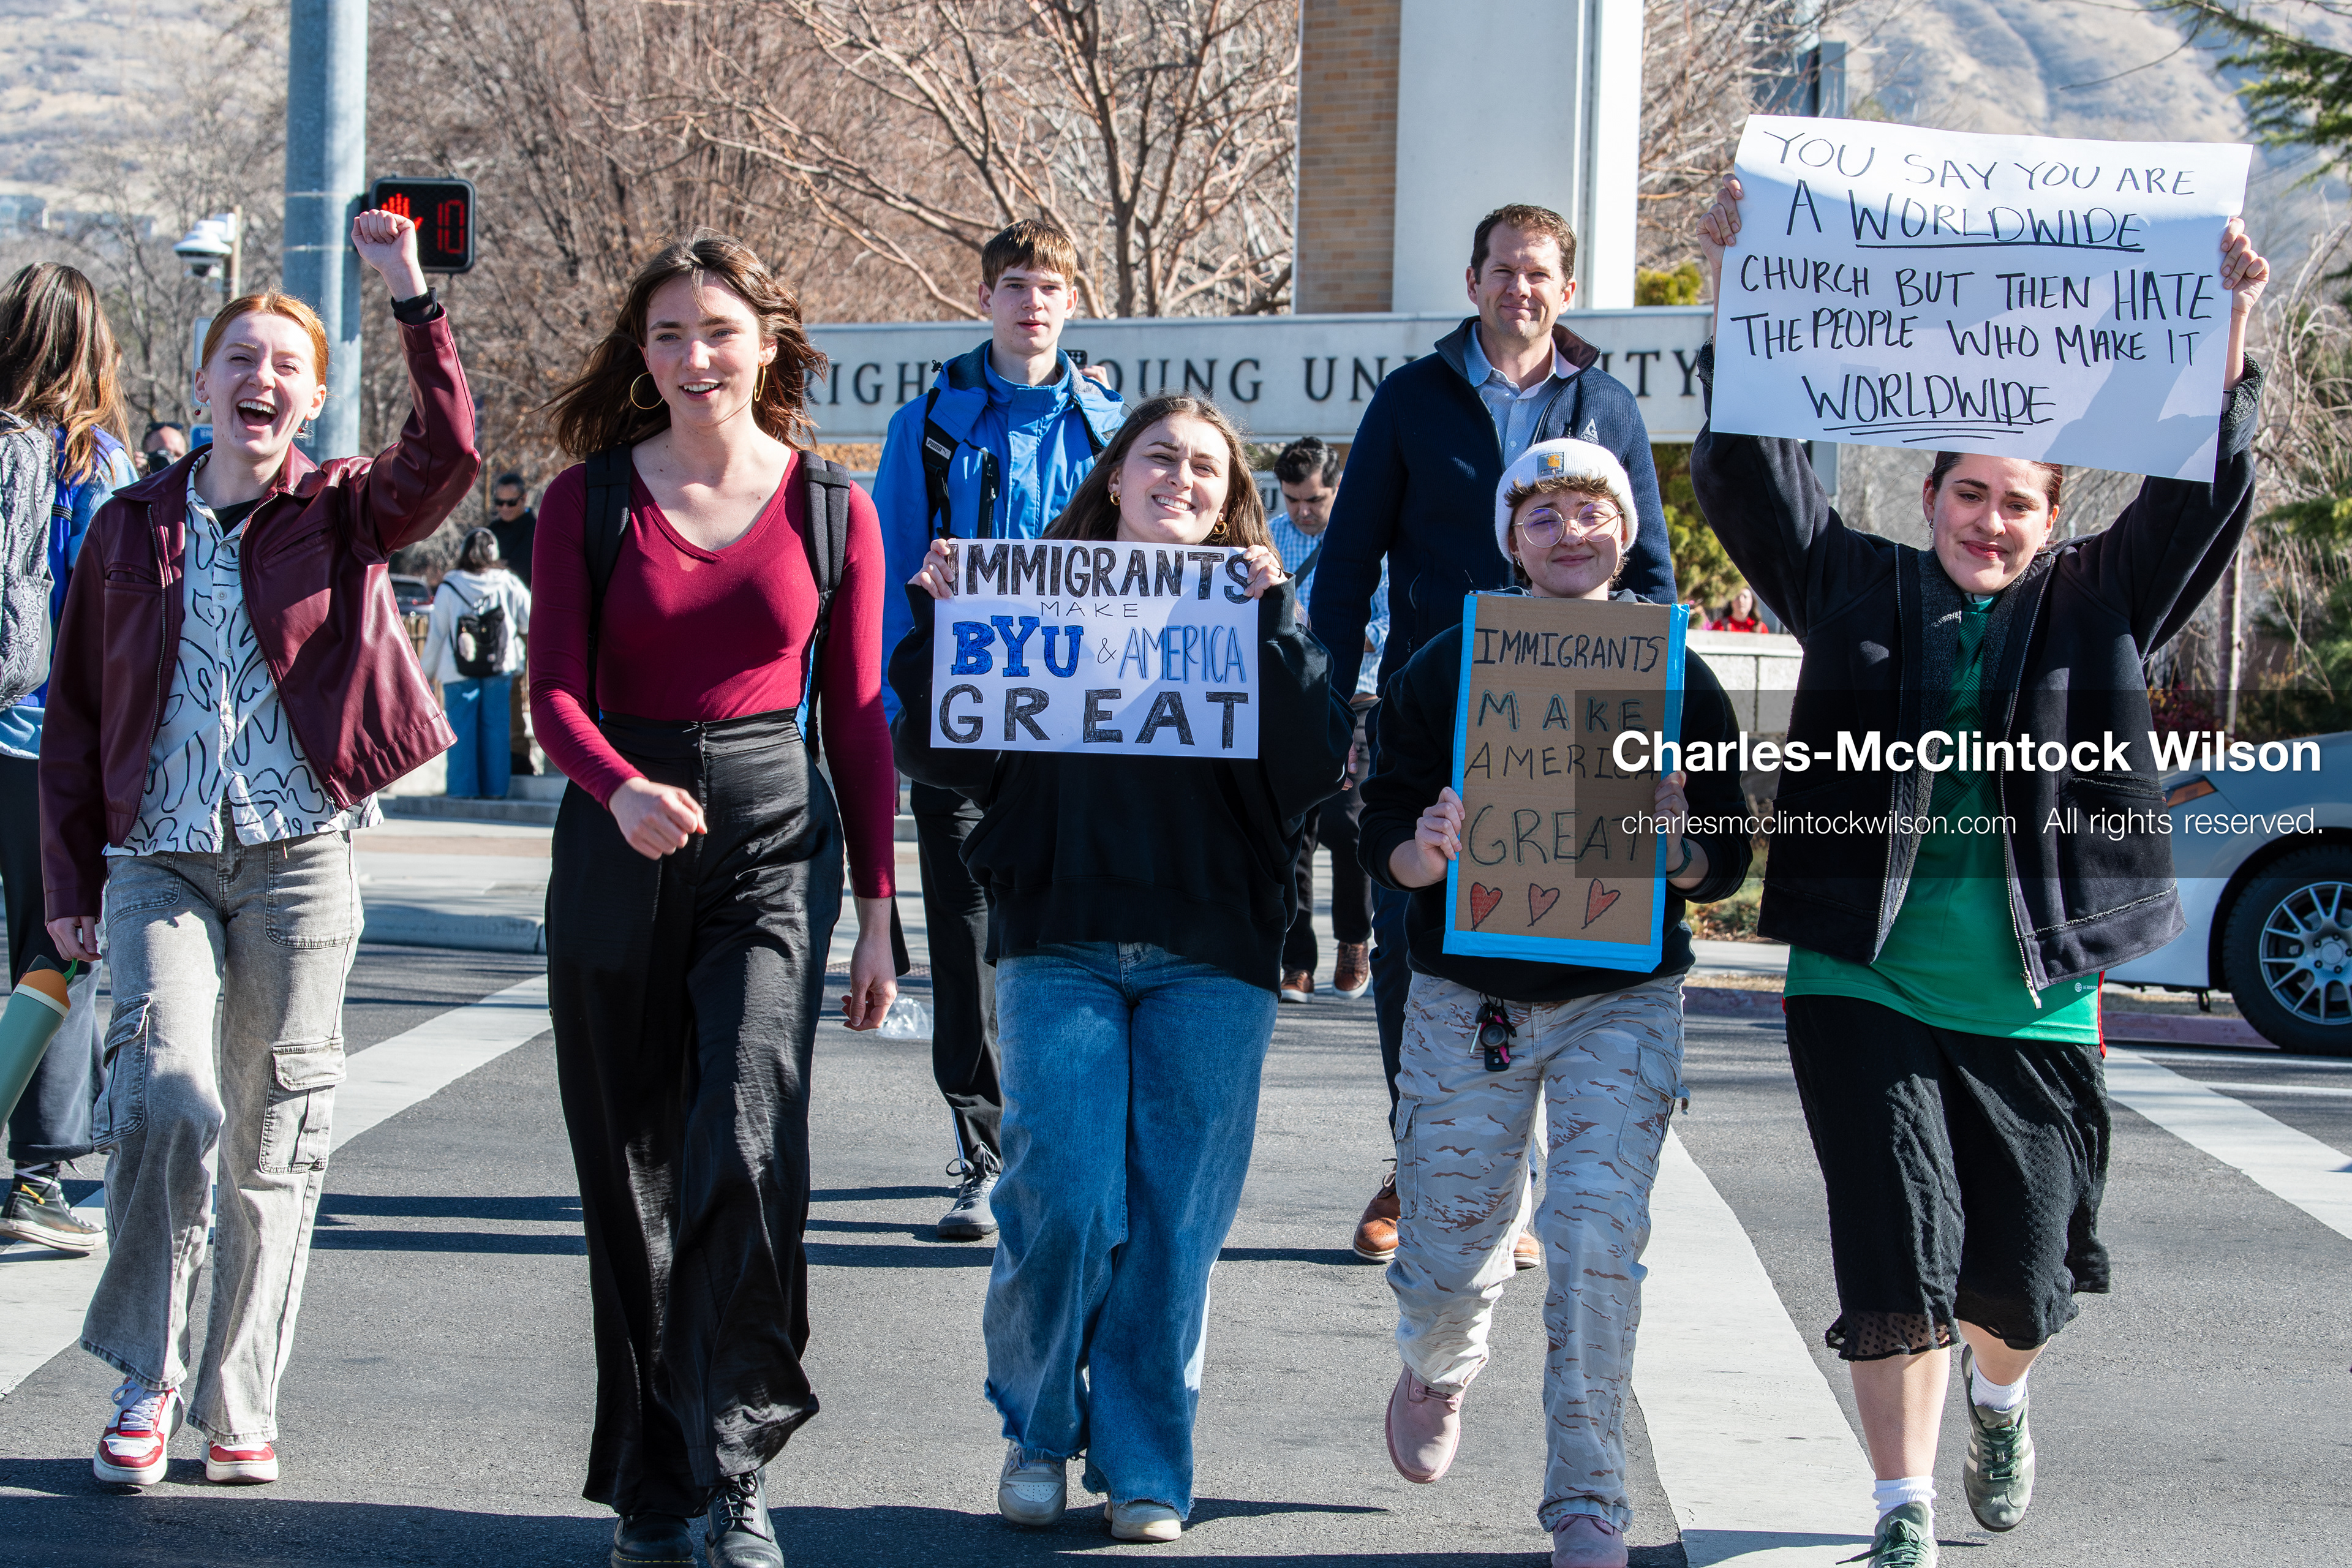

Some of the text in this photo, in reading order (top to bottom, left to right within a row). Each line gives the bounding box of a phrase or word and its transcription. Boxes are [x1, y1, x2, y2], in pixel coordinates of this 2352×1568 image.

[1763, 130, 2195, 195] YOU SAY YOU ARE
[437, 200, 465, 254] 10
[1787, 178, 2142, 247] A WORLDWIDE
[1740, 254, 2215, 322] CHURCH BUT THEN HATE
[1730, 307, 2201, 368] THE PEOPLE WHO MAKE IT
[1095, 358, 1263, 402] OUNG
[1801, 372, 2057, 424] WORLDWIDE
[927, 440, 943, 452] PUMA
[946, 543, 1254, 604] IMMIGRANTS
[1041, 601, 1138, 617] MAKE
[951, 615, 1246, 684] BYU & AMERICA
[1472, 628, 1666, 673] IMMIGRANTS
[939, 683, 1249, 750] GREAT
[1477, 690, 1649, 733] MAKE
[1464, 742, 1659, 780] AMERICA
[1469, 804, 1645, 866] GREAT
